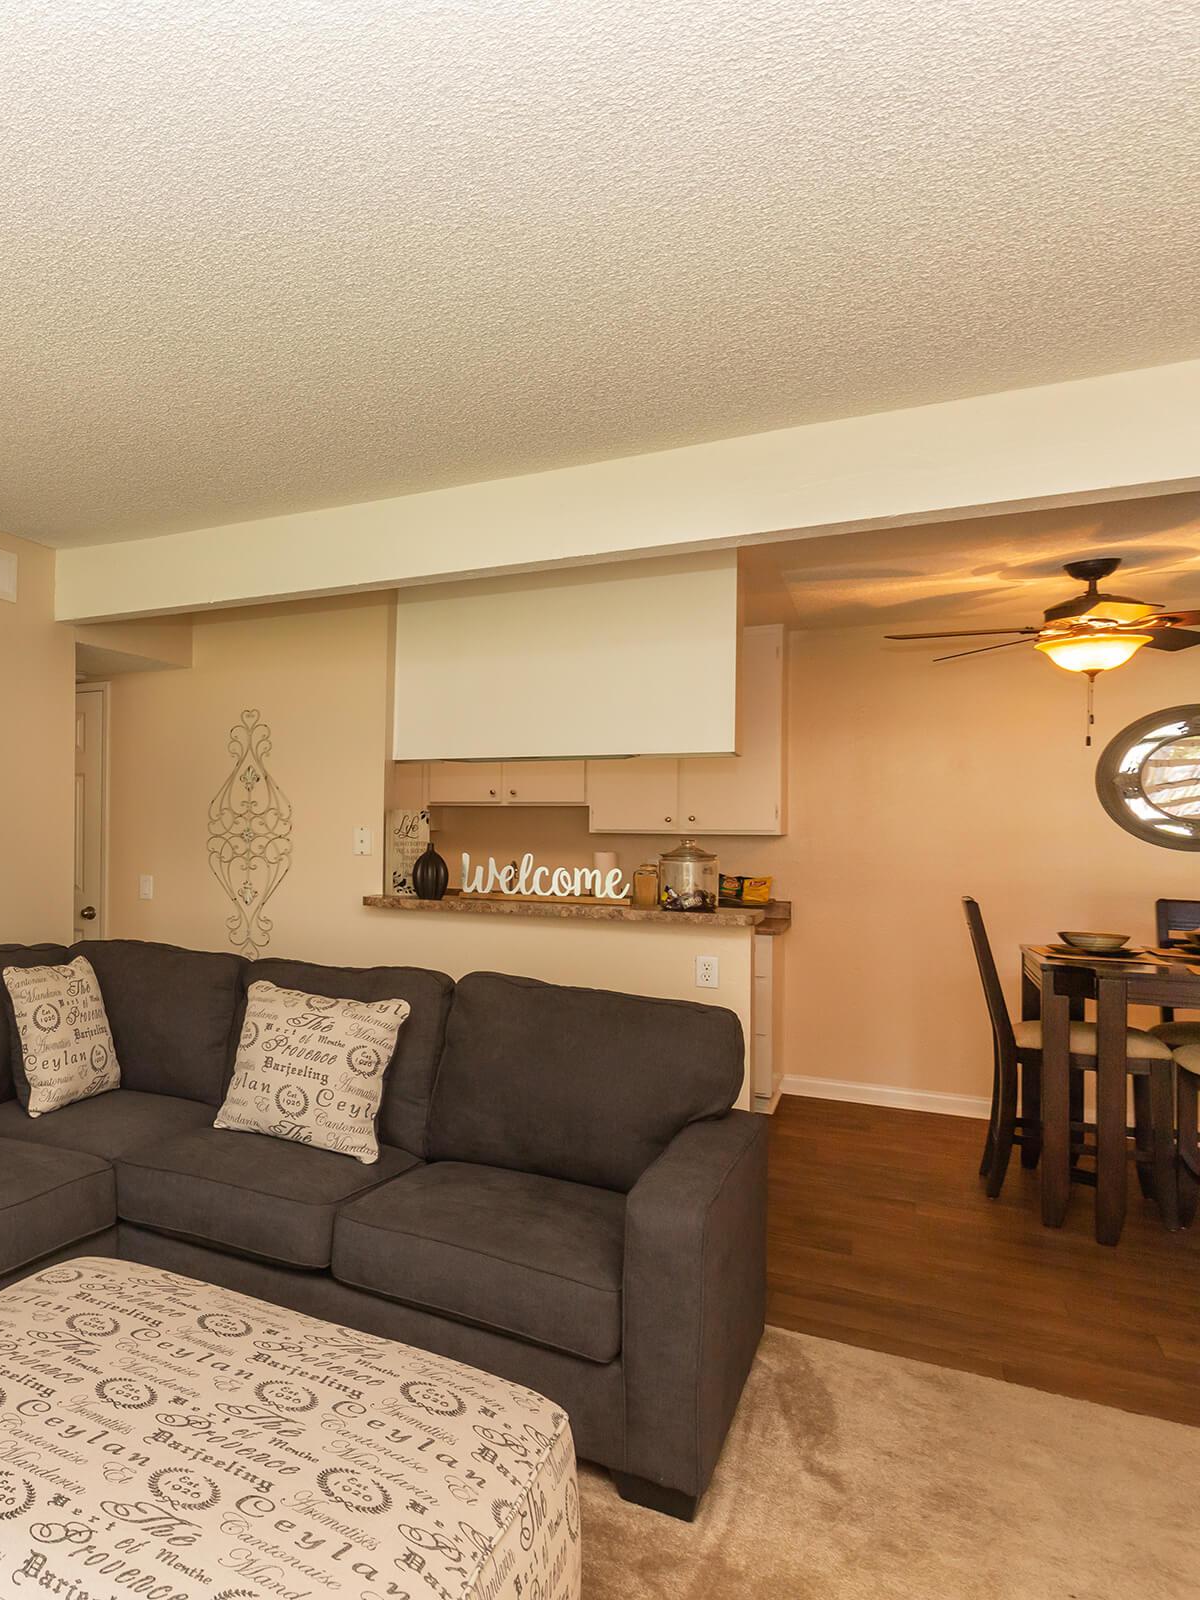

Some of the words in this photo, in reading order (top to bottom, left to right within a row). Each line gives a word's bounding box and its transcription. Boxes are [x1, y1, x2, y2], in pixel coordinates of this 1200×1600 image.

[394, 815, 420, 839] Life
[287, 1012, 335, 1033] Thé
[262, 1035, 337, 1065] Provence
[317, 1035, 346, 1048] Menthe
[24, 1050, 86, 1071] Ceylan
[262, 1056, 329, 1085] Darjeeling
[355, 1058, 373, 1068] 1926
[254, 1096, 270, 1113] Et
[282, 1098, 301, 1106] 1926
[287, 1090, 297, 1098] Est
[268, 1120, 312, 1142] Thé
[67, 1291, 164, 1327] Darjeeling
[27, 1330, 102, 1355] Thé
[130, 1328, 254, 1380] Ceylan
[64, 1356, 103, 1375] Menthe
[109, 1357, 200, 1398] Mandarin
[245, 1351, 365, 1400] Darjeeling
[253, 1341, 385, 1386] Provence
[354, 1358, 400, 1378] Menthe
[121, 1384, 140, 1393] Est
[280, 1386, 299, 1396] Est
[401, 1362, 507, 1412] Mandarin
[425, 1387, 446, 1398] Est
[16, 1399, 151, 1467] Ceylan
[215, 1402, 306, 1437] Thé
[232, 1428, 263, 1439] et
[155, 1413, 301, 1475] Provence
[268, 1436, 320, 1464] Menthe
[320, 1413, 429, 1474] Cantonaise
[332, 1401, 486, 1489] Ceylan
[142, 1427, 274, 1493] Darjeeling
[322, 1440, 440, 1507] Mandarin
[179, 1475, 199, 1489] Est
[347, 1477, 369, 1491] Est
[47, 1492, 117, 1531] Vert
[100, 1500, 203, 1546] Thé
[280, 1490, 383, 1551] Aromatisés
[114, 1537, 151, 1554] et
[220, 1511, 342, 1590] Cantonaise
[235, 1494, 410, 1600] Ceylan
[154, 1548, 213, 1585] Menthe
